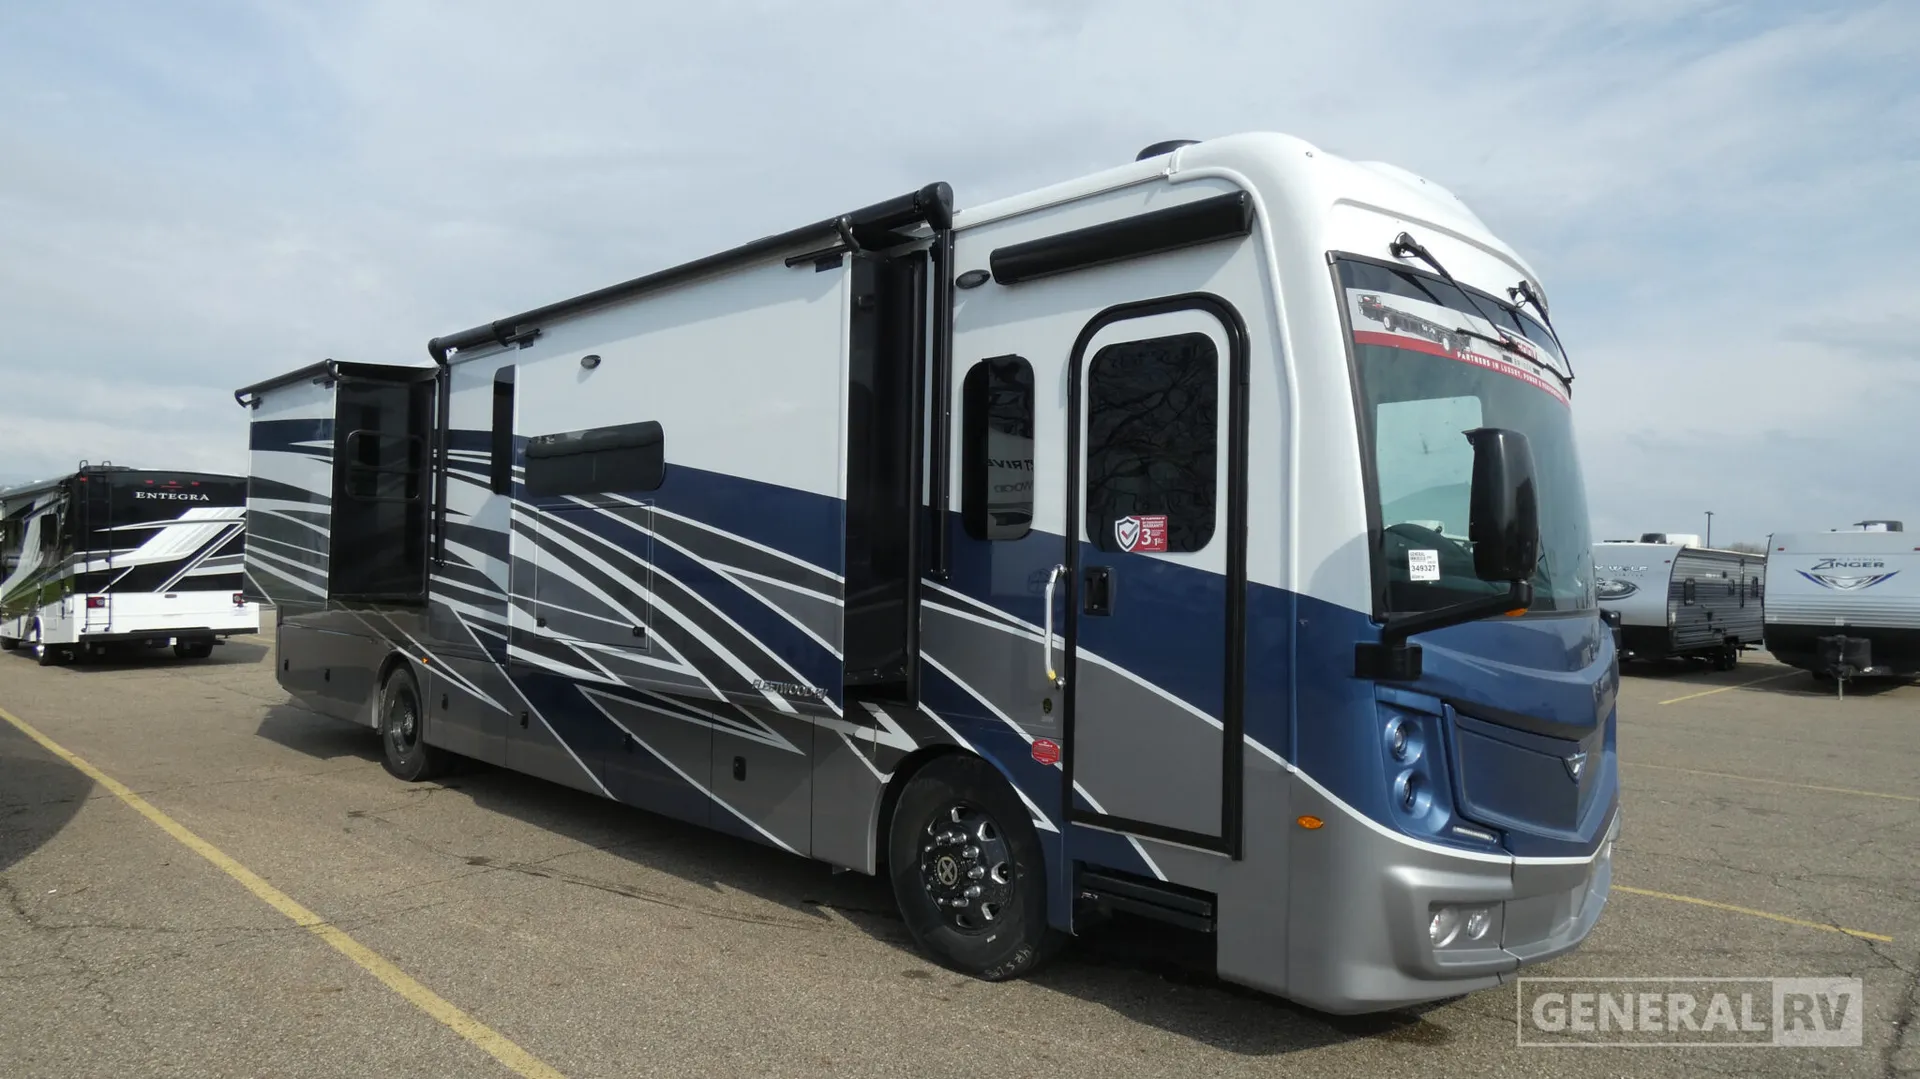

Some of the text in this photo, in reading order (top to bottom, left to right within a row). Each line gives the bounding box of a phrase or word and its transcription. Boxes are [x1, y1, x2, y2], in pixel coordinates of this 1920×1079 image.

[1456, 351, 1490, 367] PARTNERS
[1492, 361, 1499, 371] IN
[135, 491, 210, 501] ENTEGRA
[1141, 528, 1152, 545] 3
[1411, 564, 1436, 572] 349327
[1811, 558, 1885, 571] ZINGER
[752, 679, 812, 697] FLEETWOOD
